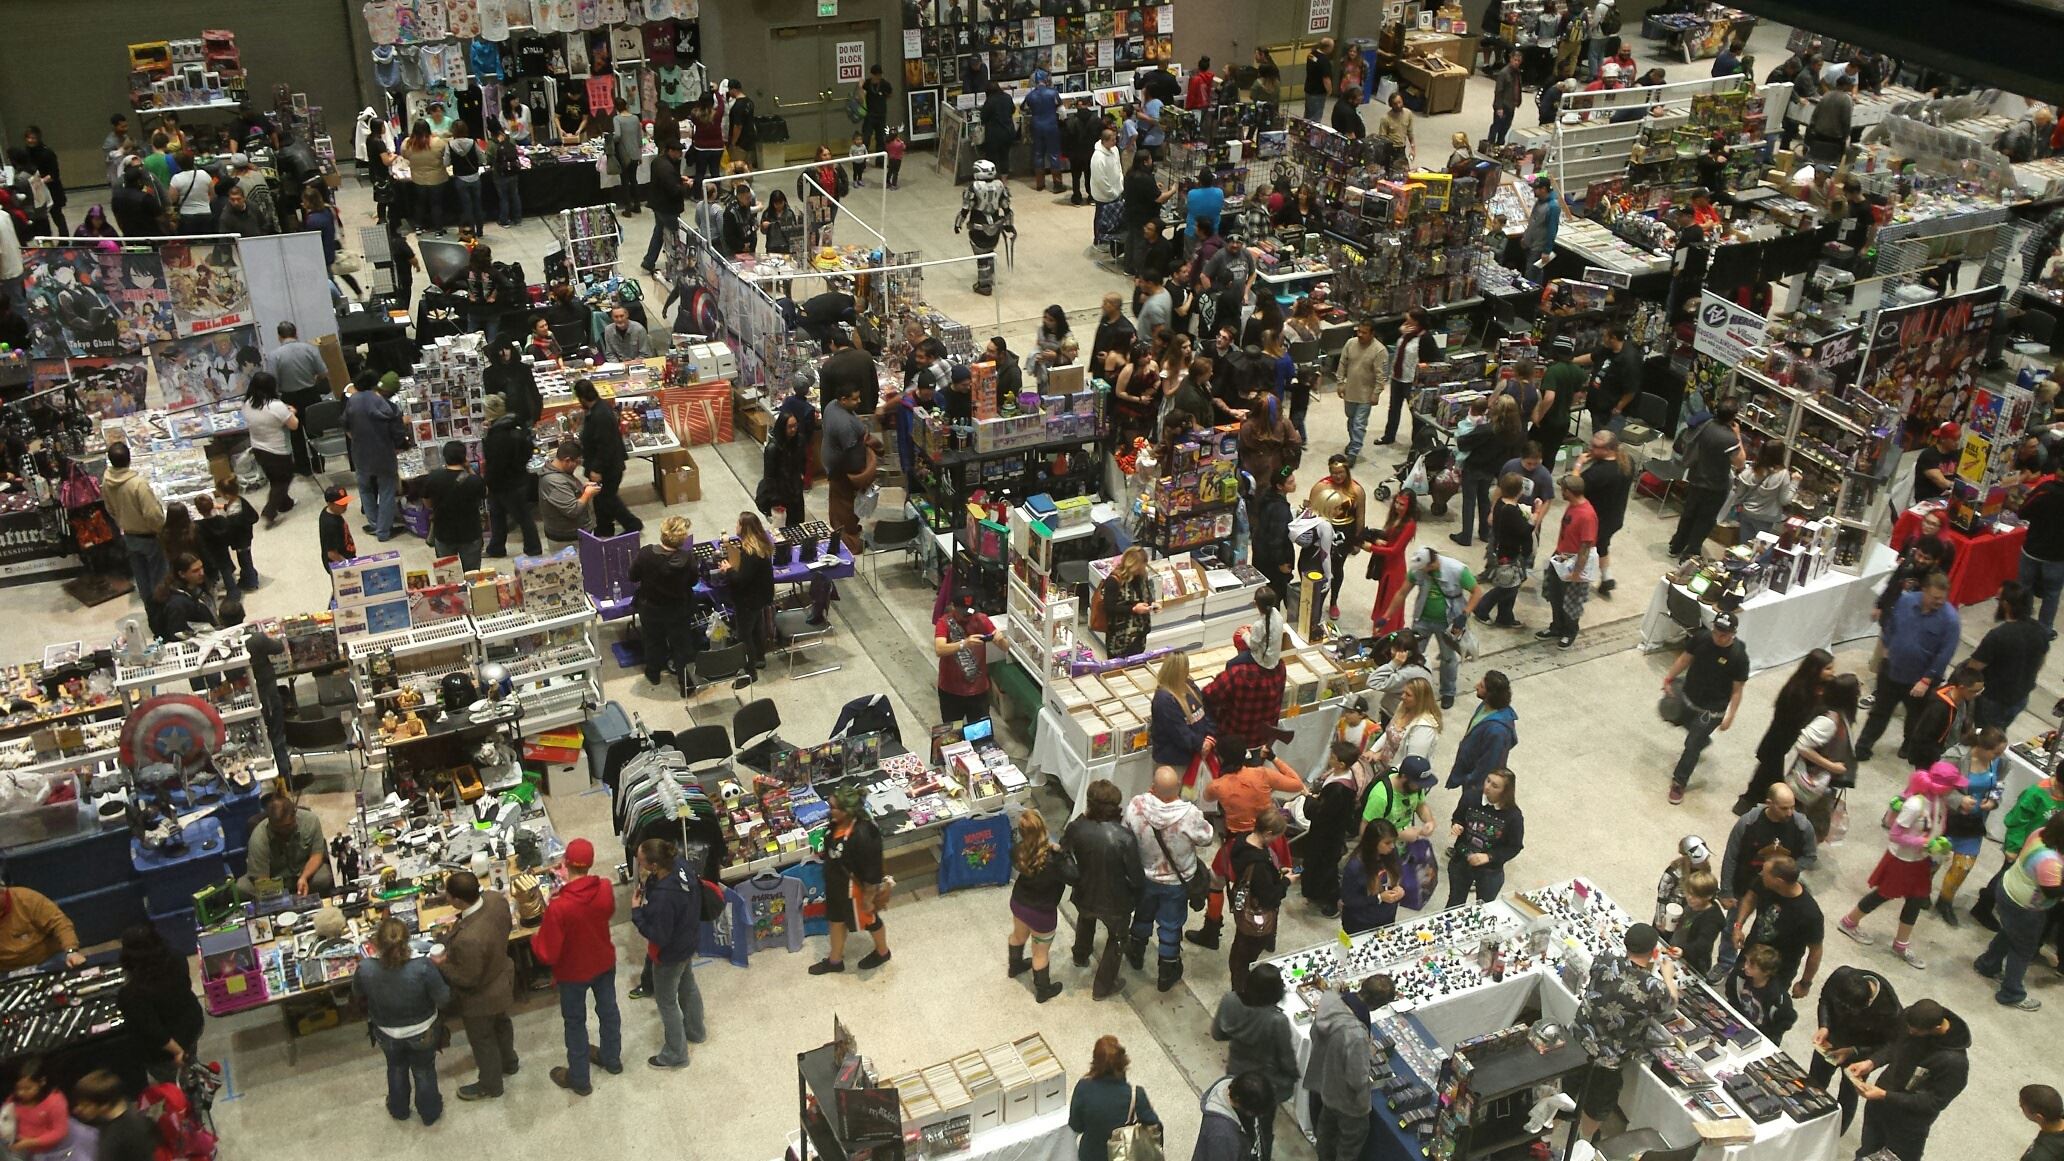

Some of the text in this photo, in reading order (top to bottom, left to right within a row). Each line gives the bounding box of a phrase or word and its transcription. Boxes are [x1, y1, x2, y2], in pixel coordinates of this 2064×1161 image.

[1312, 8, 1330, 16] BLOCK
[1312, 18, 1328, 28] EXIT
[839, 45, 862, 54] DO NOT
[839, 55, 862, 64] BLOCK
[841, 67, 860, 78] EXIT
[68, 338, 115, 350] Tokyo Ghoul
